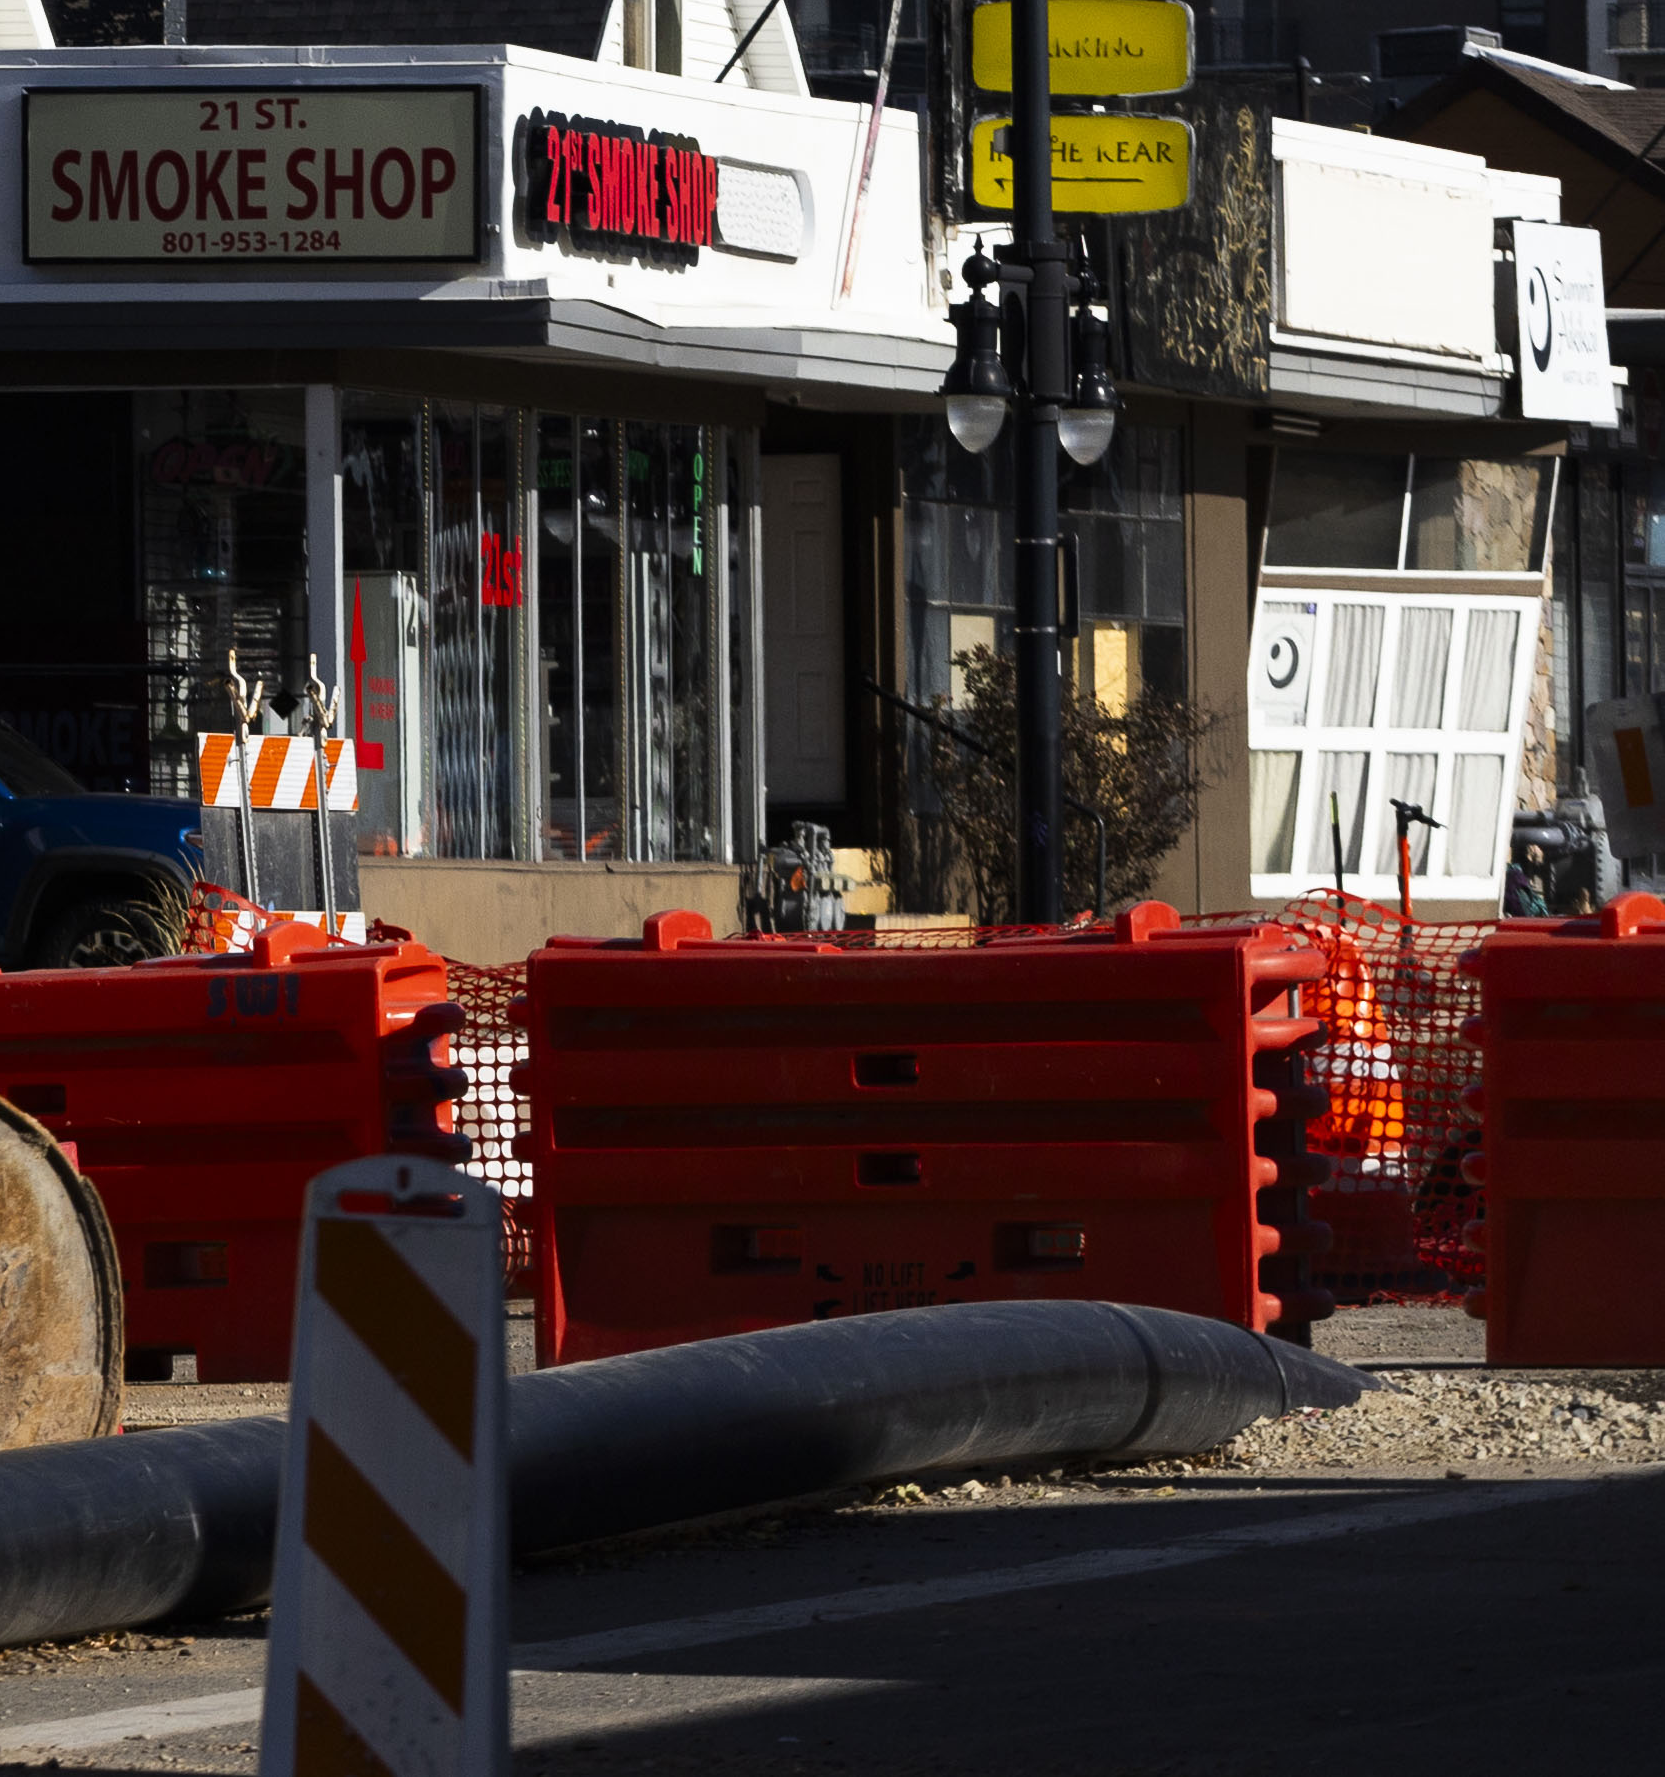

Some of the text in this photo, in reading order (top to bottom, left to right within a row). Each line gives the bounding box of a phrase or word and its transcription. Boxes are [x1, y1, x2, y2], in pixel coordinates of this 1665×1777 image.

[199, 98, 308, 131] 21 ST.
[50, 146, 457, 223] SMOKE SHOP
[587, 132, 661, 239] SMOKE
[665, 145, 718, 248] SHOP
[161, 230, 342, 254] 801-953-1284
[863, 1262, 926, 1288] NO LIFT
